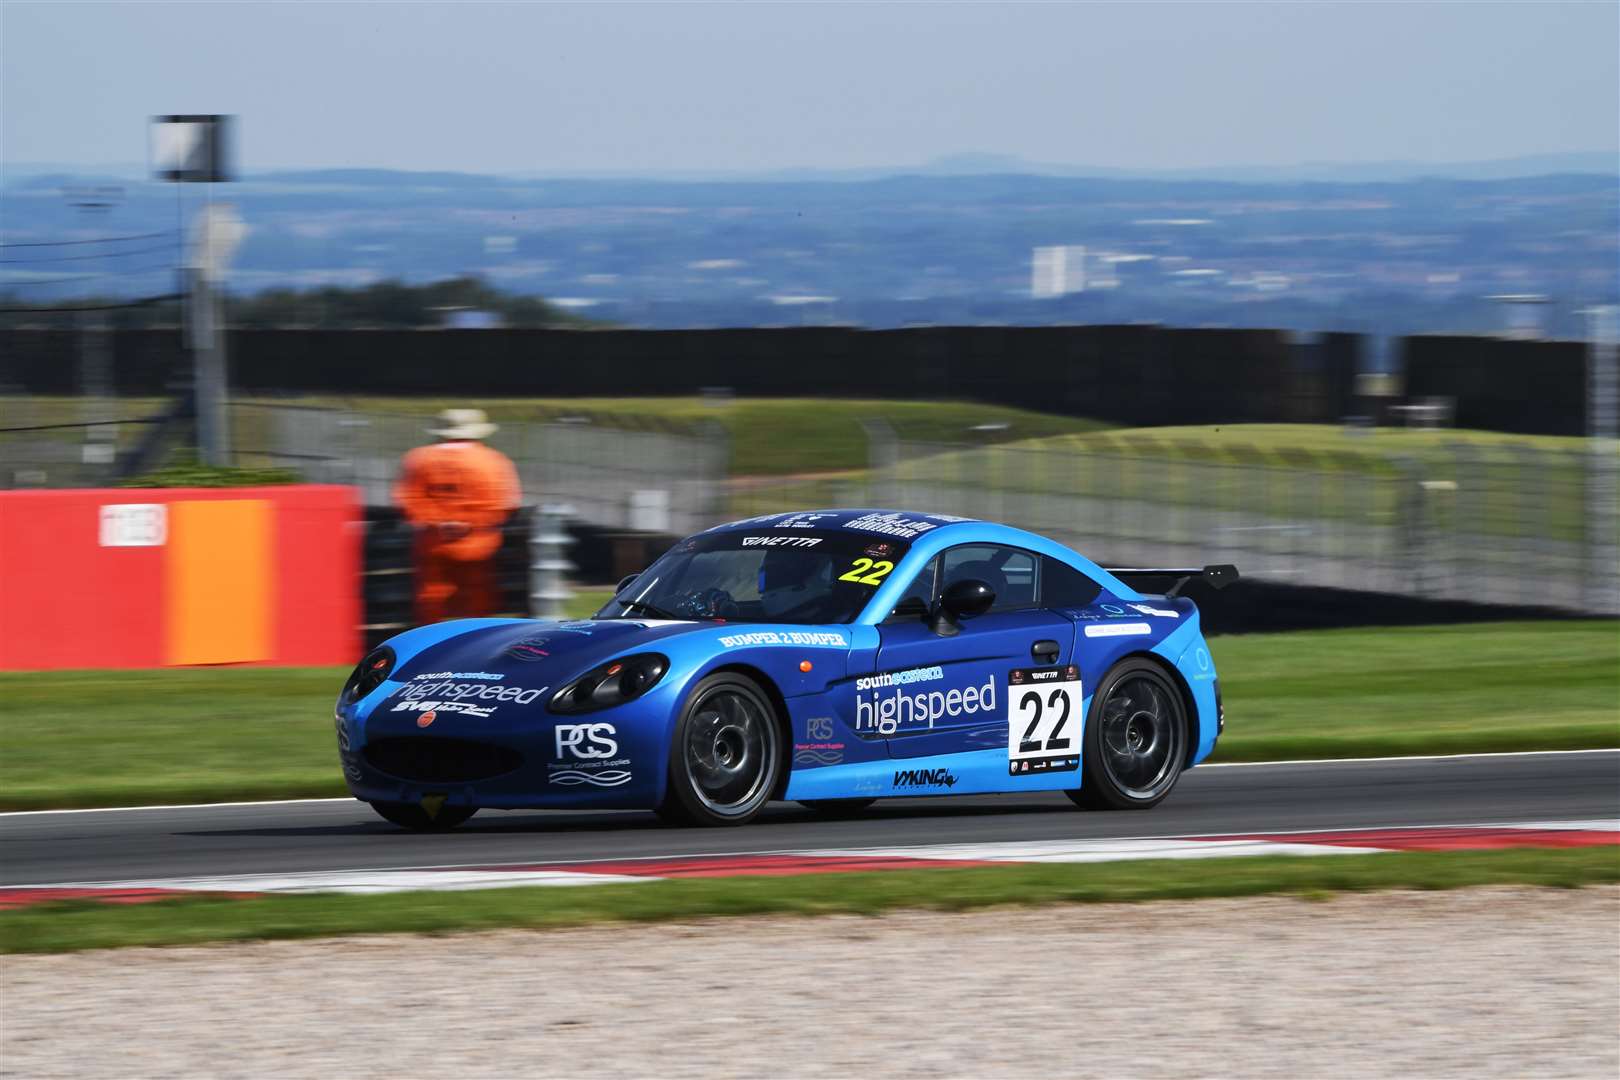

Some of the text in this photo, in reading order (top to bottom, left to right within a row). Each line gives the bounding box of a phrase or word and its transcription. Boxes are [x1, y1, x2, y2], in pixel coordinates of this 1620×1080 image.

[742, 536, 823, 547] GINETTA
[838, 558, 894, 586] 22
[718, 632, 847, 647] BUMPER 2 BUMPER
[856, 666, 944, 690] southeastern
[390, 680, 549, 704] highspeed
[855, 674, 996, 735] highspeed
[806, 717, 833, 740] PCS
[1018, 688, 1071, 753] 22
[555, 722, 618, 759] PCS
[893, 768, 947, 788] VYKING
